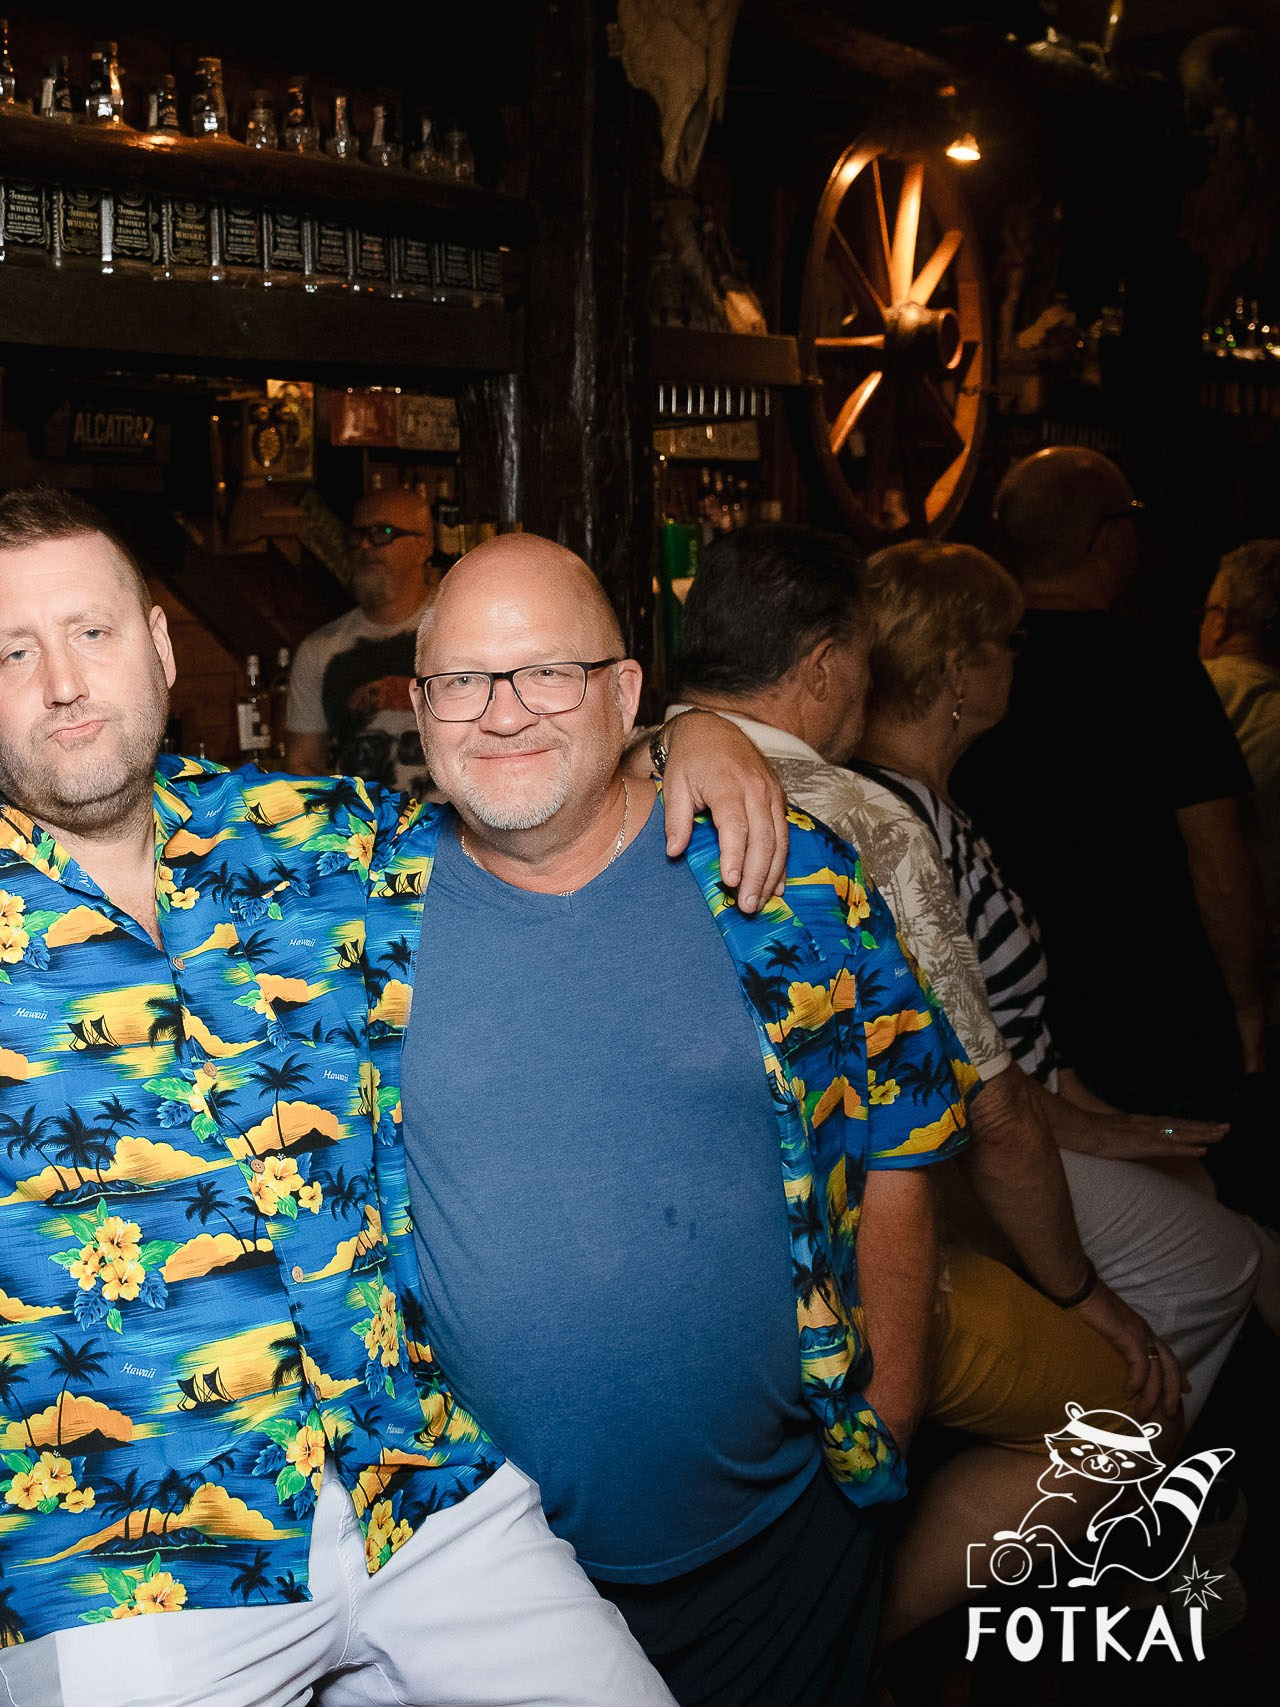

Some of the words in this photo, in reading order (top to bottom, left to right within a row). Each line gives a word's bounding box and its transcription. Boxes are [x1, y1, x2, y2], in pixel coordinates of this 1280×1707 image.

[10, 204, 39, 214] WHISKEY
[66, 218, 98, 230] WHISKEY
[73, 412, 154, 446] ALCATRAZ
[289, 938, 316, 948] Hawaii
[12, 1007, 48, 1020] Hawaii
[323, 1070, 349, 1082] Hawaii
[121, 1362, 156, 1379] Hawaii
